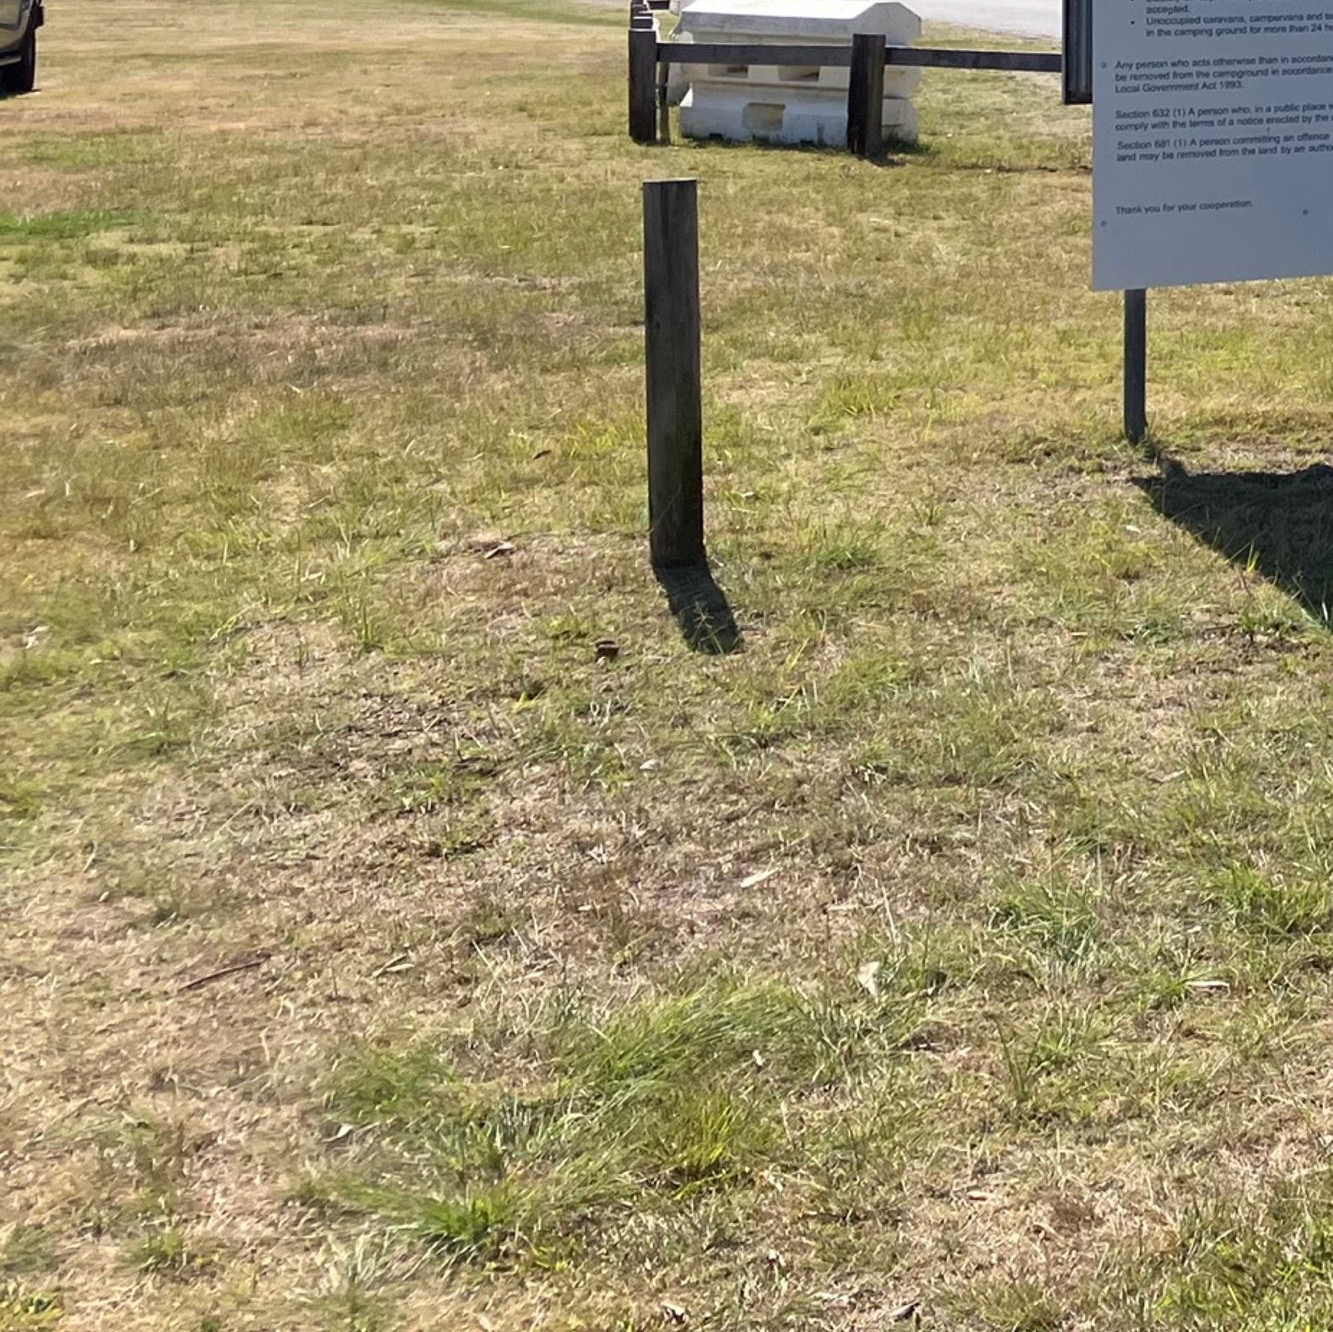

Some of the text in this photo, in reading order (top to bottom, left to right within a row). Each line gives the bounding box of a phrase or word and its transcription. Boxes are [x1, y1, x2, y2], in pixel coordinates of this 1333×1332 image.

[1156, 27, 1171, 35] the
[1174, 26, 1213, 37] camping
[1215, 25, 1247, 36] ground
[1249, 25, 1261, 33] for
[1288, 24, 1308, 32] than
[1115, 60, 1133, 70] Any
[1135, 60, 1168, 69] person
[1170, 58, 1189, 66] who
[1192, 57, 1210, 66] acts
[1212, 56, 1256, 65] otherwise
[1258, 55, 1278, 64] than
[1114, 83, 1140, 92] Local
[1142, 81, 1199, 91] Government
[1201, 81, 1216, 90] Act
[1116, 204, 1142, 213] Thank
[1144, 205, 1160, 214] you
[1162, 203, 1174, 211] for
[1177, 204, 1196, 212] your
